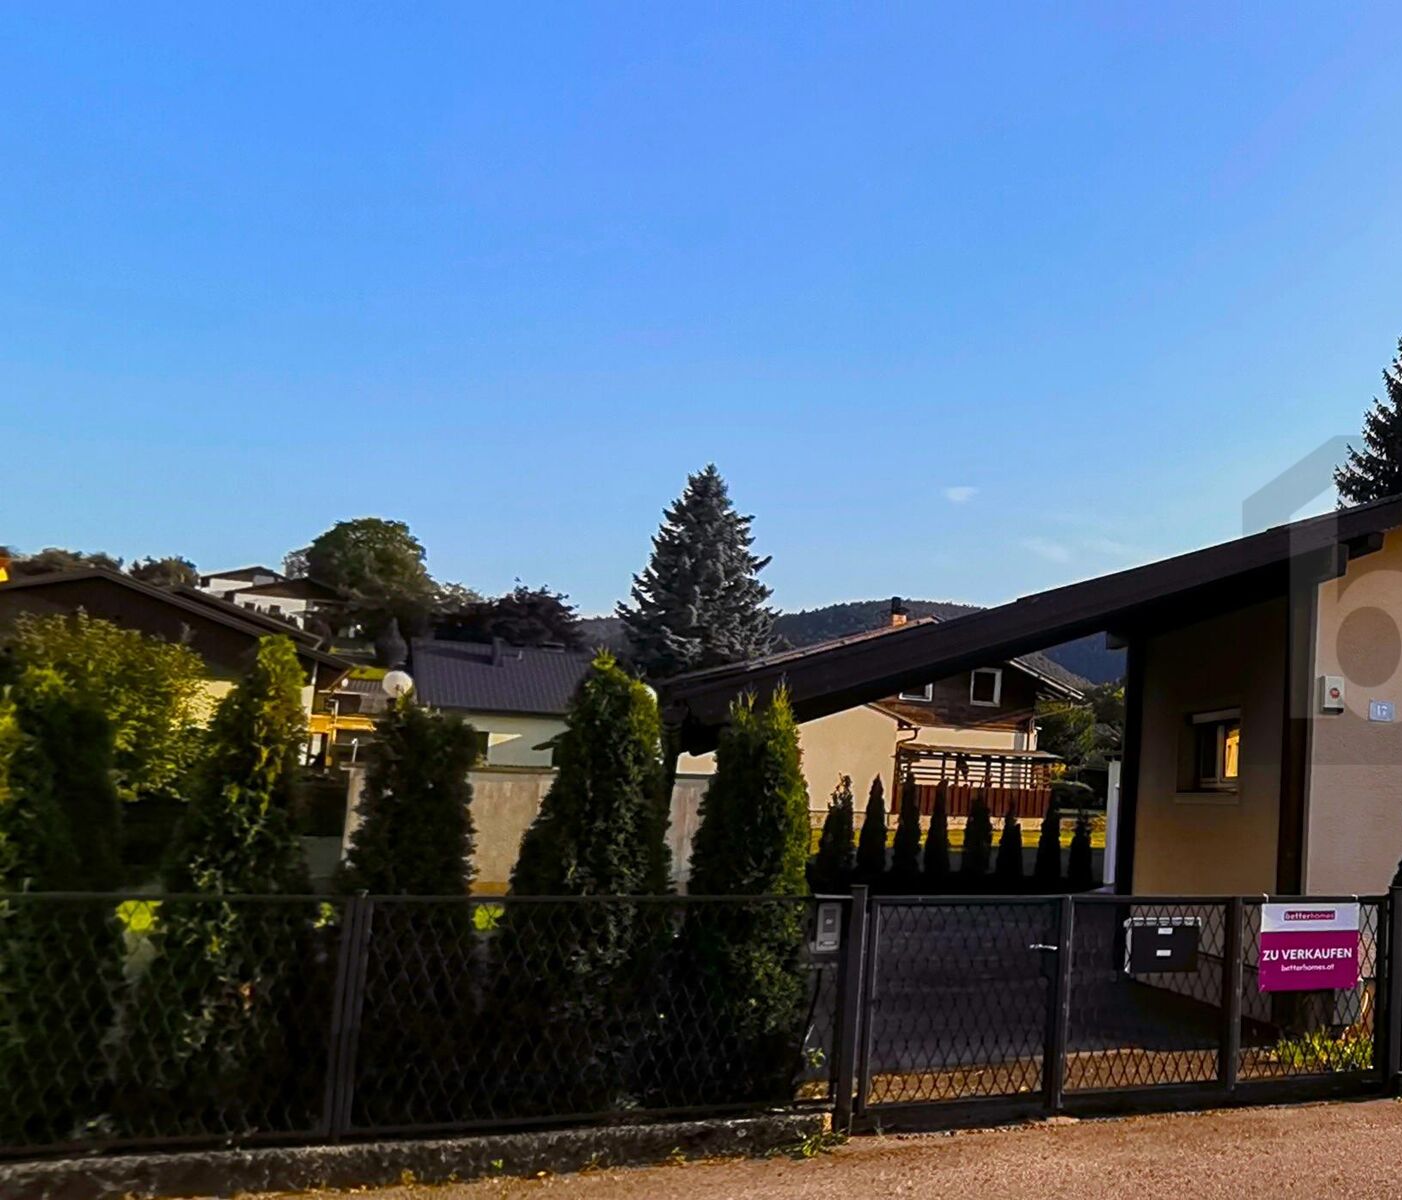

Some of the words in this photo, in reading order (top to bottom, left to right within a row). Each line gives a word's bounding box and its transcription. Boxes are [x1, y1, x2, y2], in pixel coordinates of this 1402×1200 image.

[1285, 911, 1335, 920] betterhomes
[1262, 949, 1279, 961] ZU
[1281, 947, 1353, 960] VERKAUFEN
[1281, 963, 1335, 972] betterhomes.at
